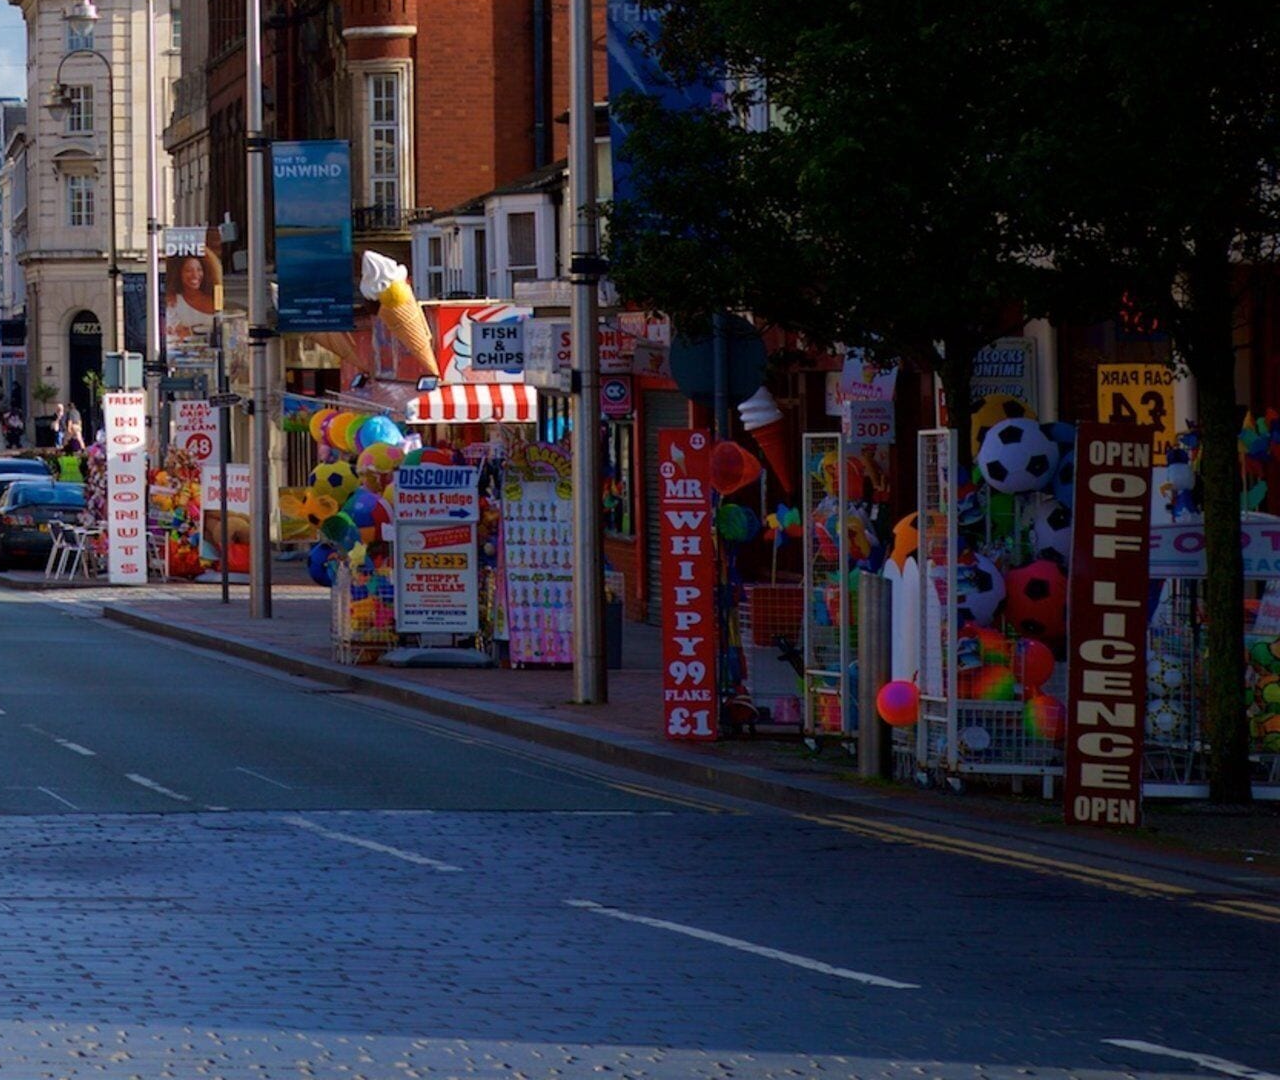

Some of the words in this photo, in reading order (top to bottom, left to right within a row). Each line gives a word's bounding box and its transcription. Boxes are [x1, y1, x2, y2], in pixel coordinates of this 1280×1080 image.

[274, 164, 342, 178] UNWIND
[166, 243, 206, 257] DINE
[482, 327, 518, 339] FISH
[494, 341, 506, 352] &
[476, 352, 524, 364] CHIPS
[972, 350, 1024, 363] LCOCKS
[108, 397, 143, 405] FRESH
[179, 410, 212, 418] DAIRY
[856, 422, 890, 437] 30P
[112, 416, 140, 463] HOT
[188, 438, 210, 455] 48
[1088, 439, 1150, 468] OPEN
[399, 468, 473, 487] DISCOUNT
[665, 478, 704, 499] MR
[398, 492, 427, 505] Rock
[429, 493, 437, 505] &
[439, 492, 473, 506] Fudge
[1088, 472, 1148, 560] OFF
[113, 475, 140, 574] DONUTS
[404, 552, 468, 570] FREE
[415, 574, 460, 583] WHIPPY
[664, 510, 707, 656] WHIPPY
[406, 583, 424, 592] ICE
[427, 583, 465, 592] CREAM
[668, 659, 707, 686] 99
[1076, 580, 1143, 790] LICENCE
[664, 689, 712, 702] FLAKE
[667, 706, 713, 736] £1
[1072, 794, 1136, 825] OPEN
